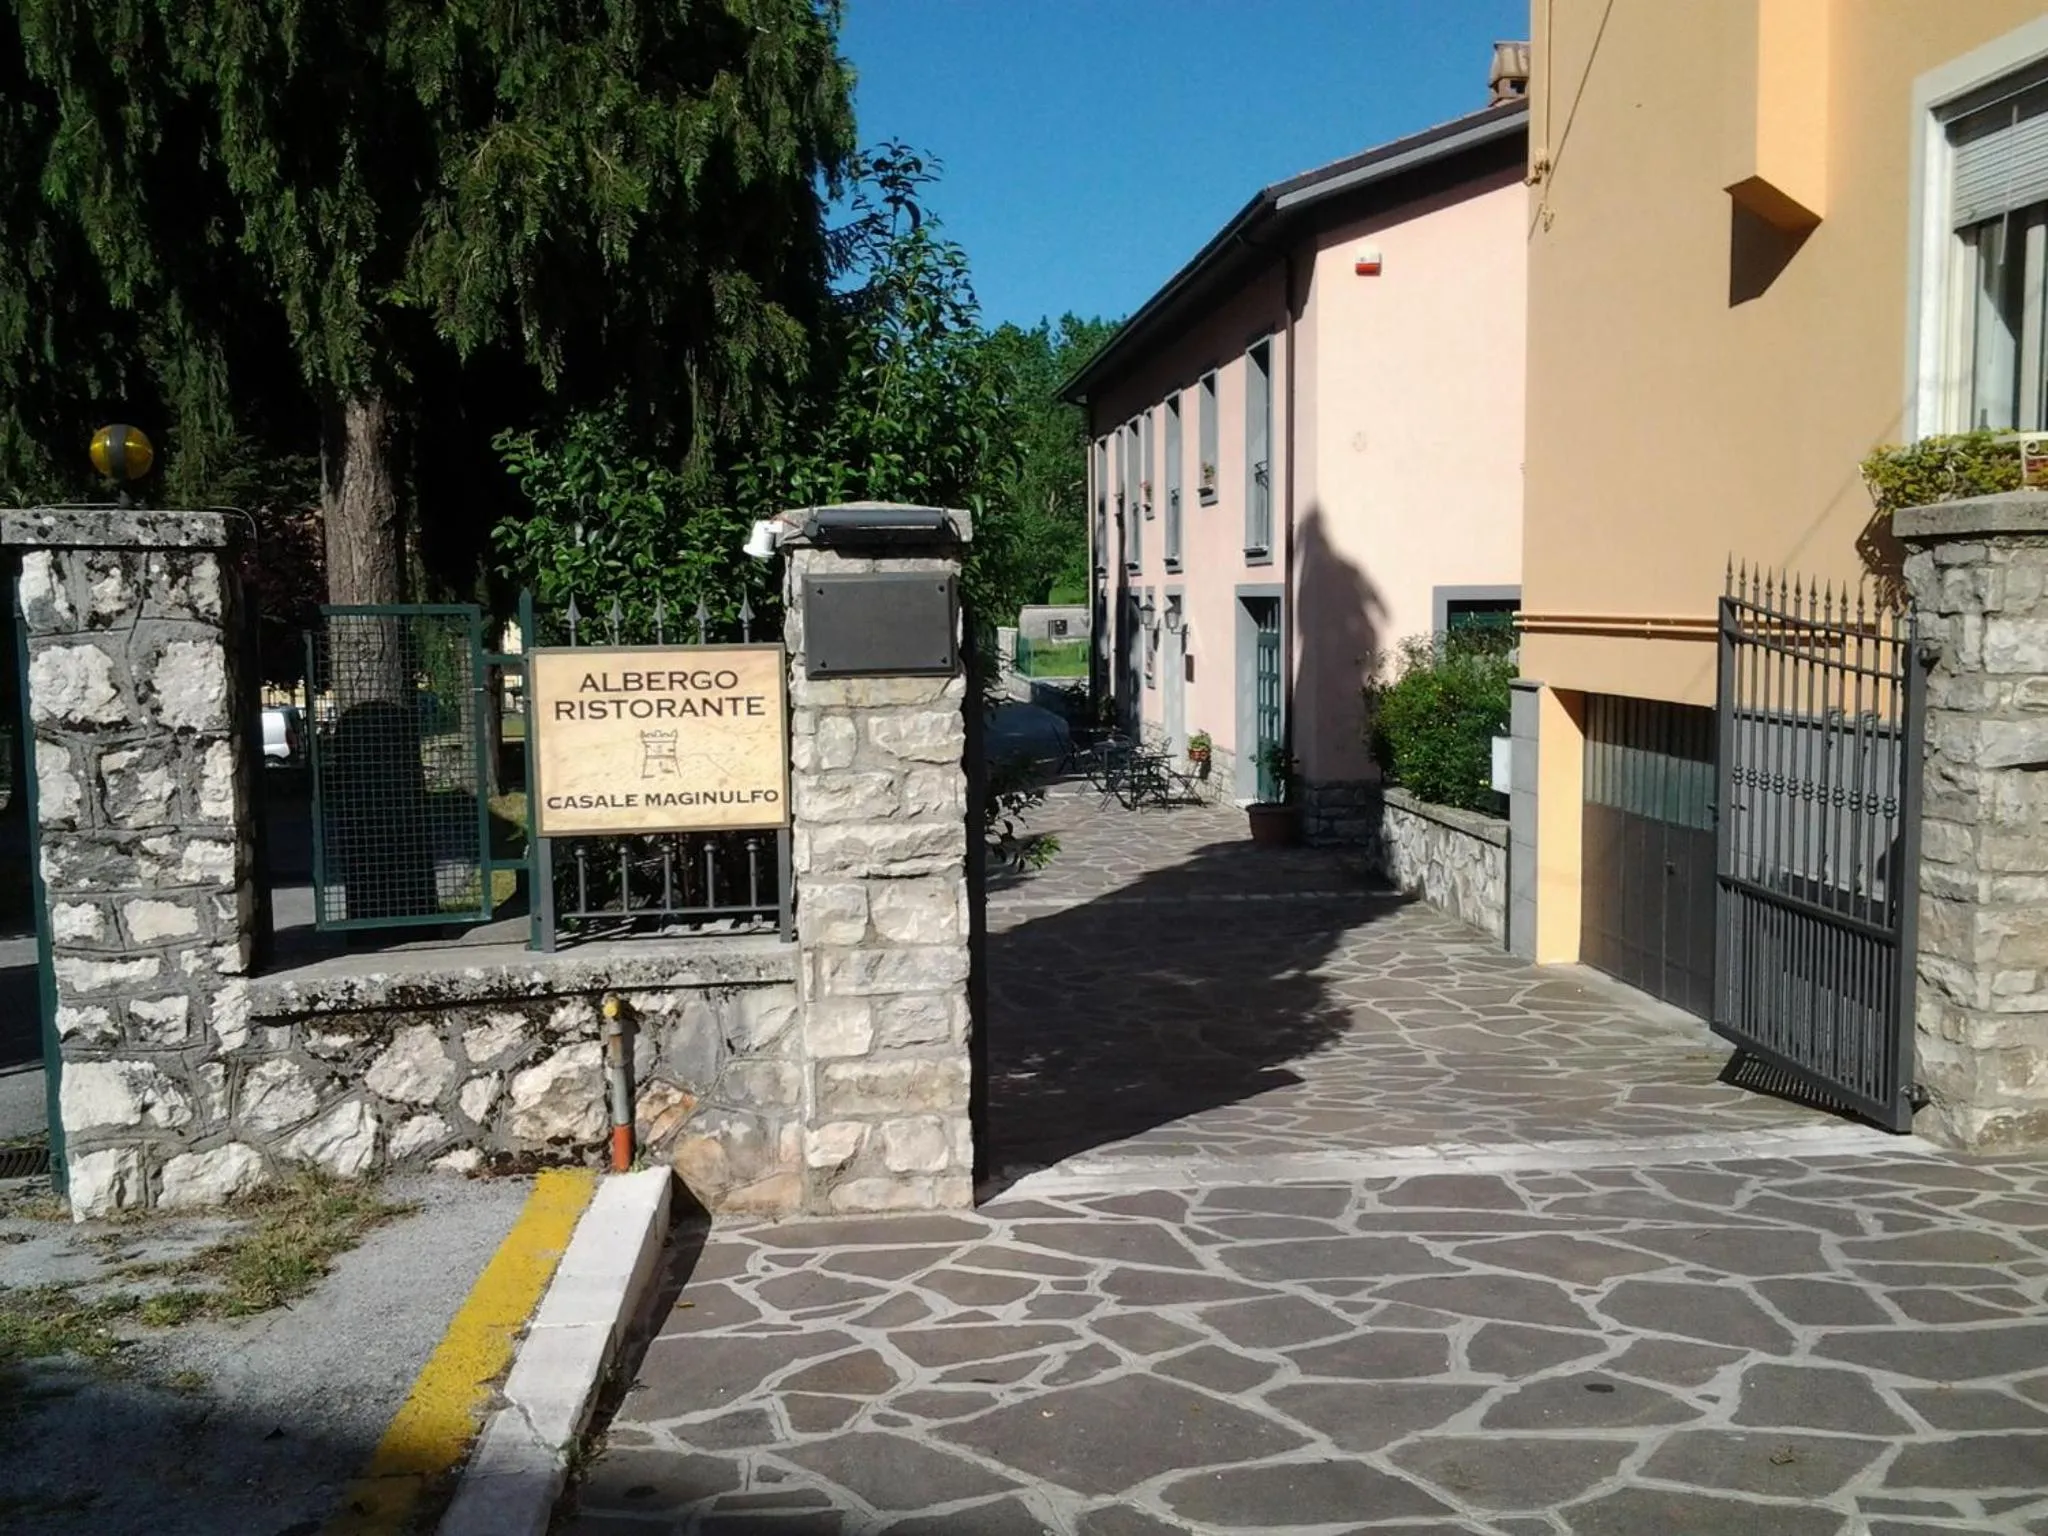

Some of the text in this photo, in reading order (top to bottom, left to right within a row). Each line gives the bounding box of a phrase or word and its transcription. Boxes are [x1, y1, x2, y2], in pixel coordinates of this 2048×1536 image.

[579, 670, 738, 692] ALBERGO
[555, 697, 765, 720] RISTORANTE
[547, 789, 779, 809] CASALE MAGINULFO
